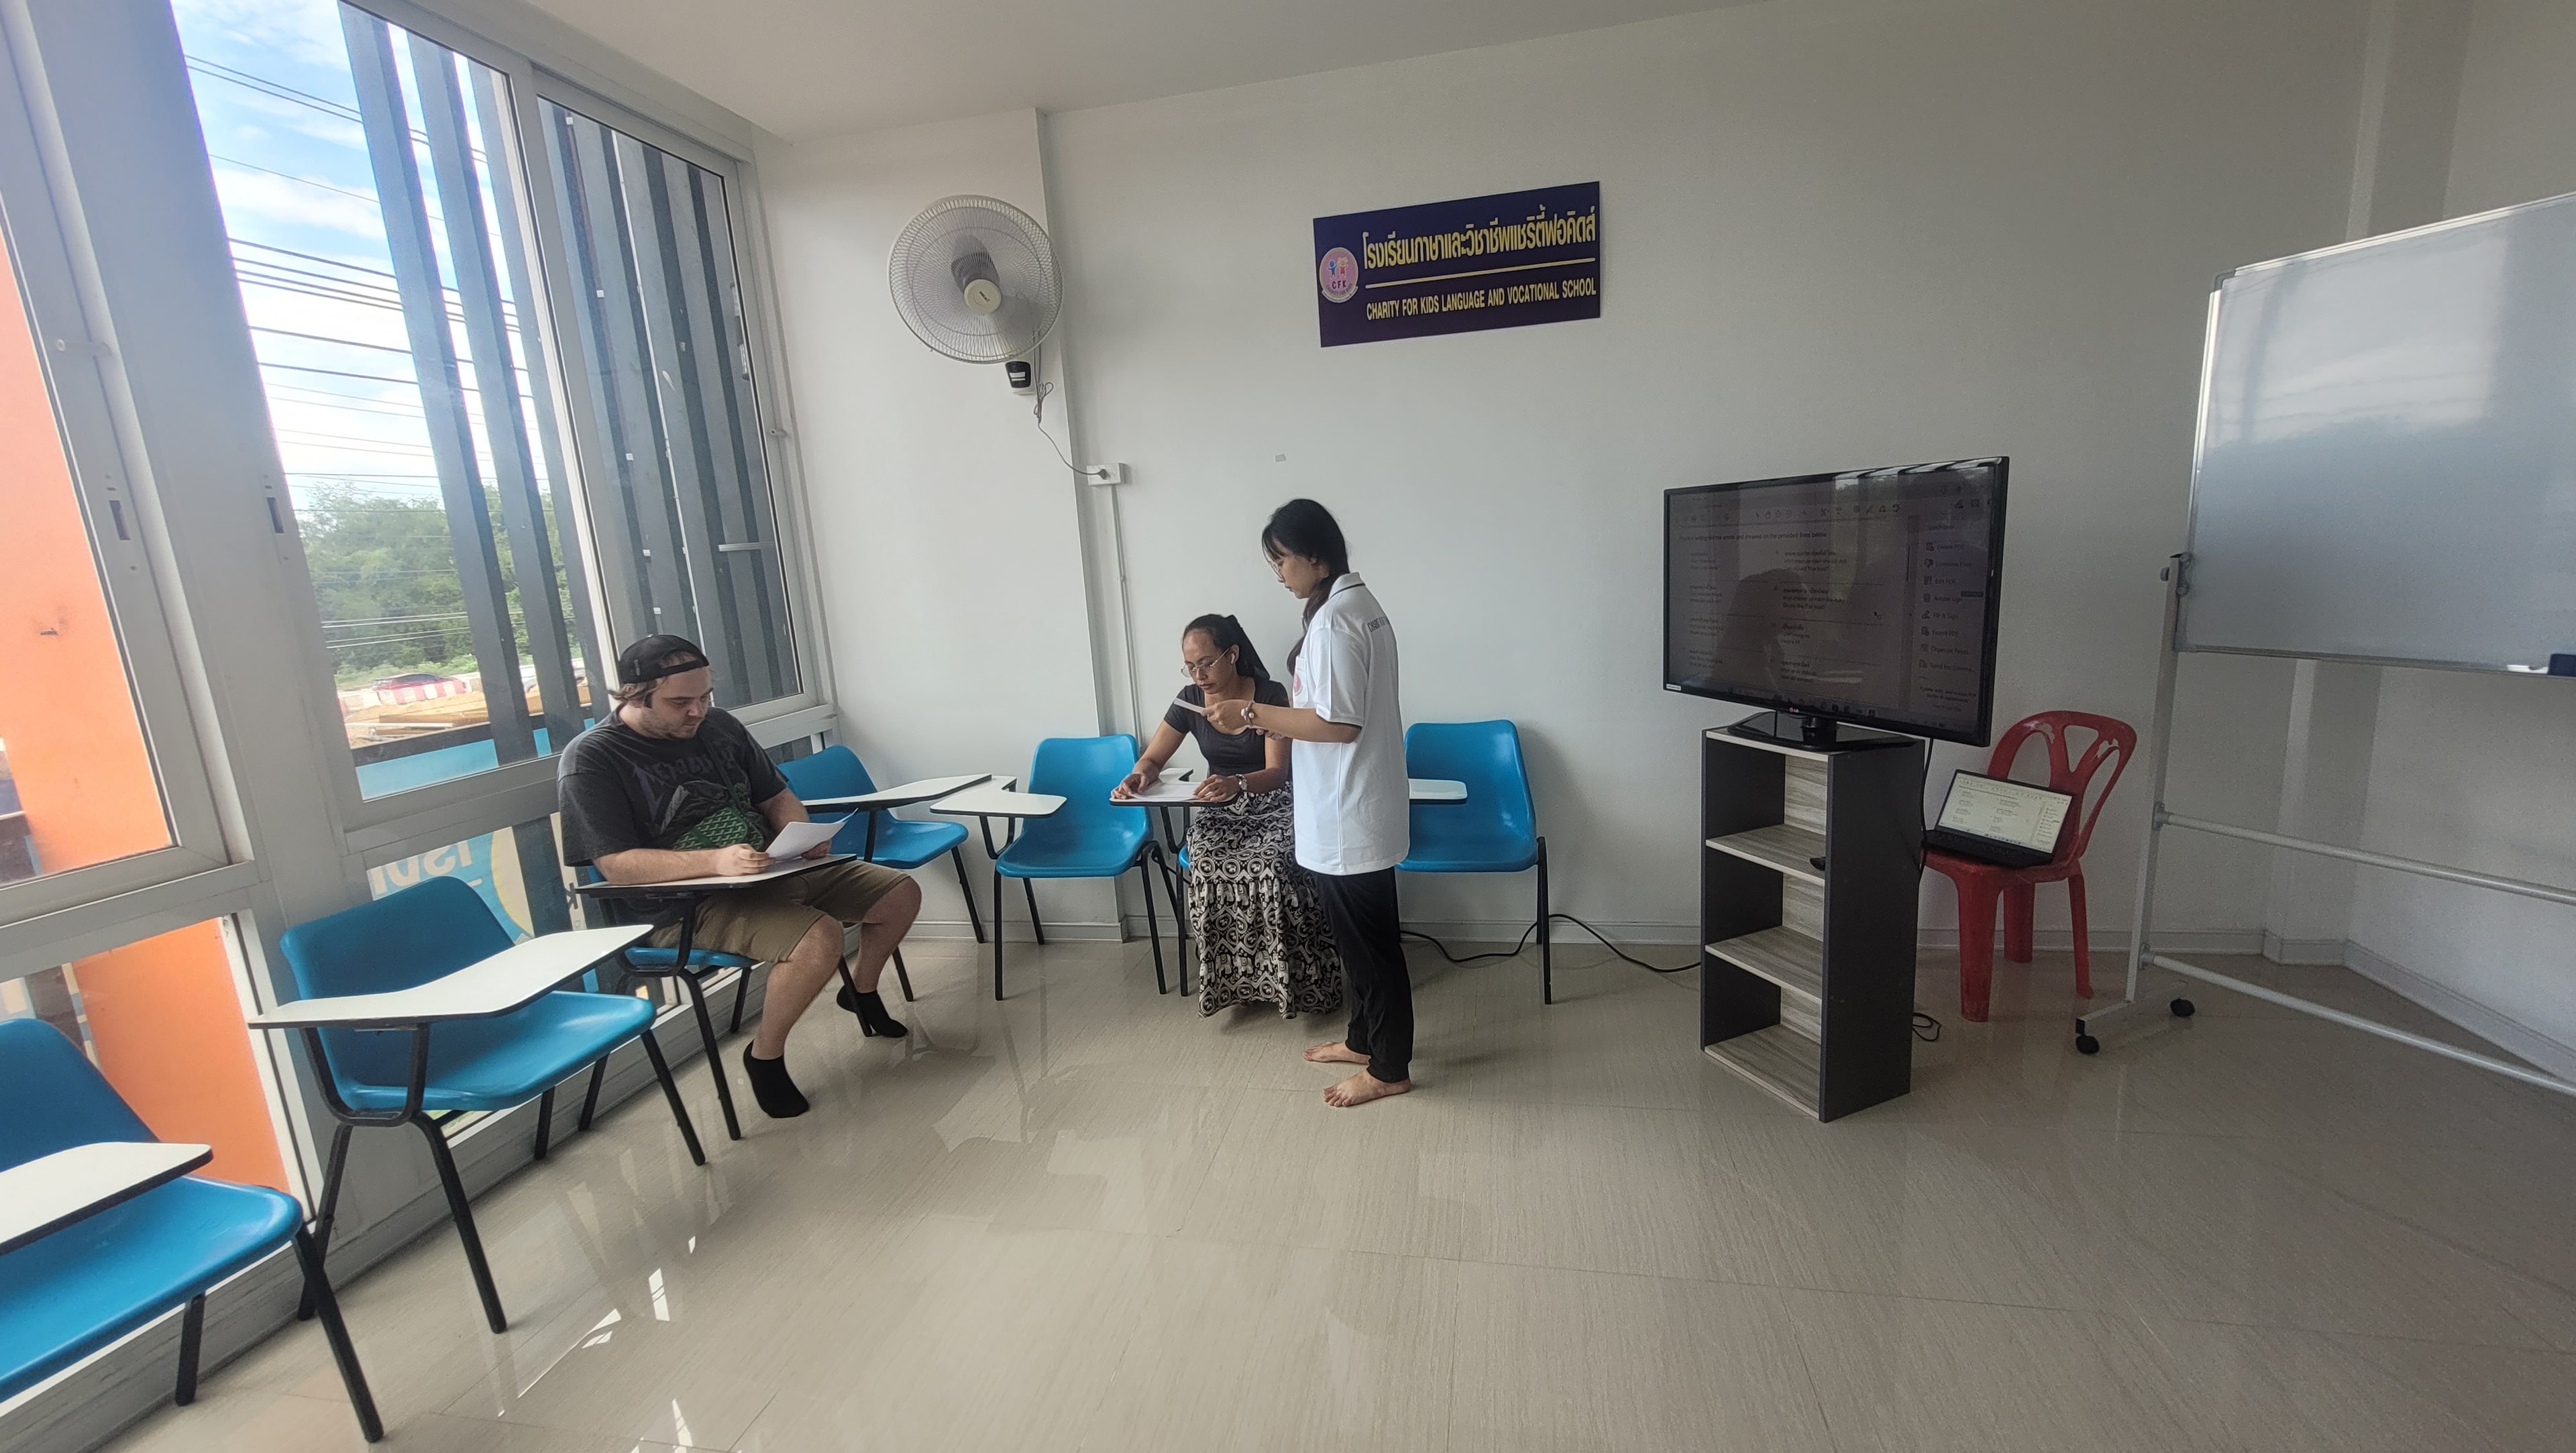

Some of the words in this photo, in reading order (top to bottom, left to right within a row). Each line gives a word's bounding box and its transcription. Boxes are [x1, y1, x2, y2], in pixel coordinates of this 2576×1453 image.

[1332, 280, 1347, 289] CFK
[1366, 300, 1400, 321] CHARITY
[1402, 298, 1419, 316] FOR
[1420, 294, 1440, 315] KIDS
[1442, 290, 1485, 312] LANGUAGE
[1487, 287, 1505, 307] AND
[1507, 281, 1560, 304] VOCATIONAL
[1562, 277, 1597, 299] SCHOOL
